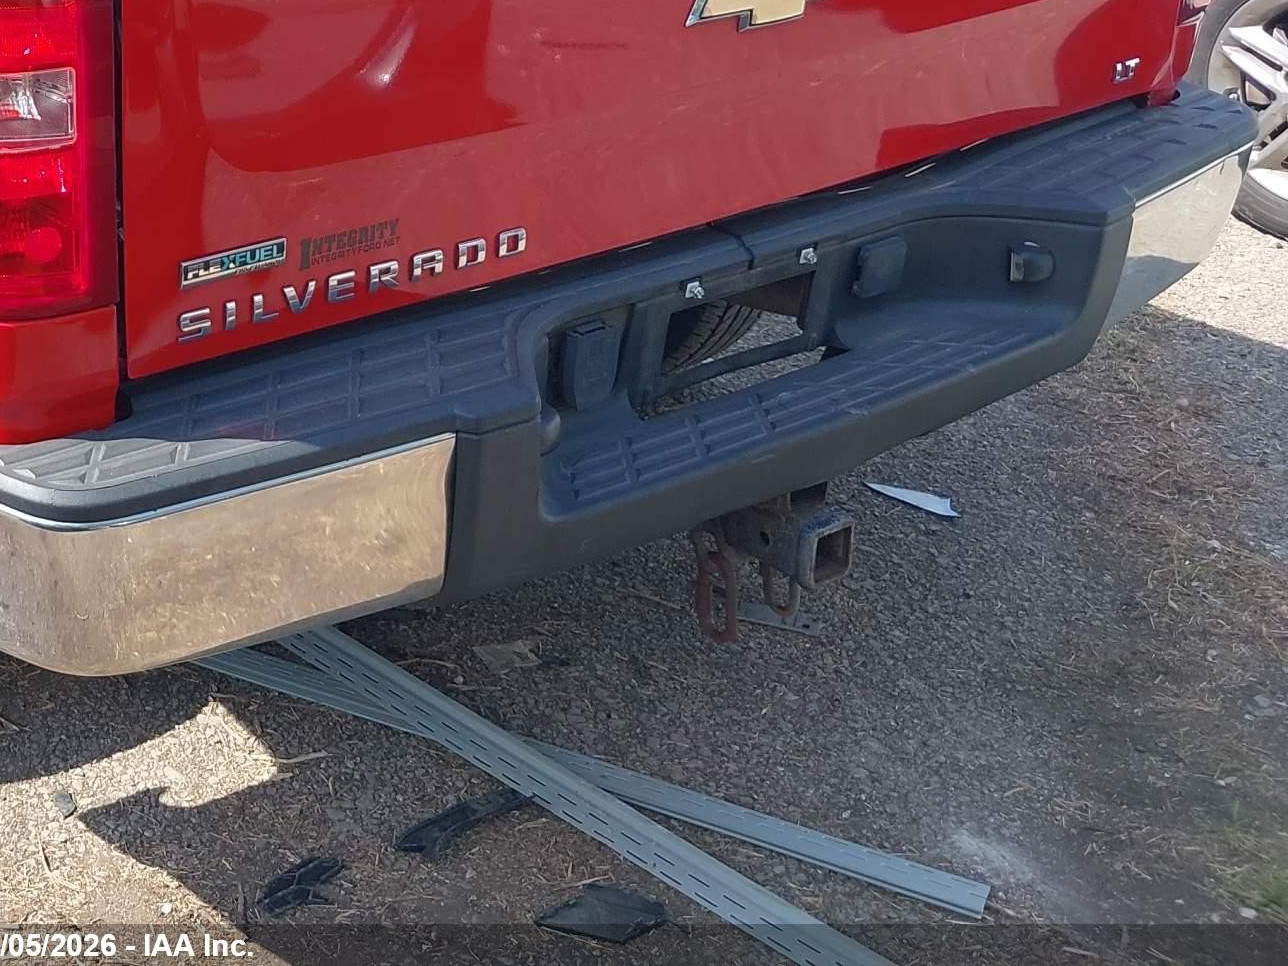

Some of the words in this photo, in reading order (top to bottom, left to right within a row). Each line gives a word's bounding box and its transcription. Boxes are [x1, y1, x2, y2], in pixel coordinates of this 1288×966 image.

[1114, 57, 1140, 83] LT
[187, 244, 283, 279] FLEXFUEL
[299, 218, 399, 272] INTEGRITY
[178, 226, 528, 344] SILVERADO
